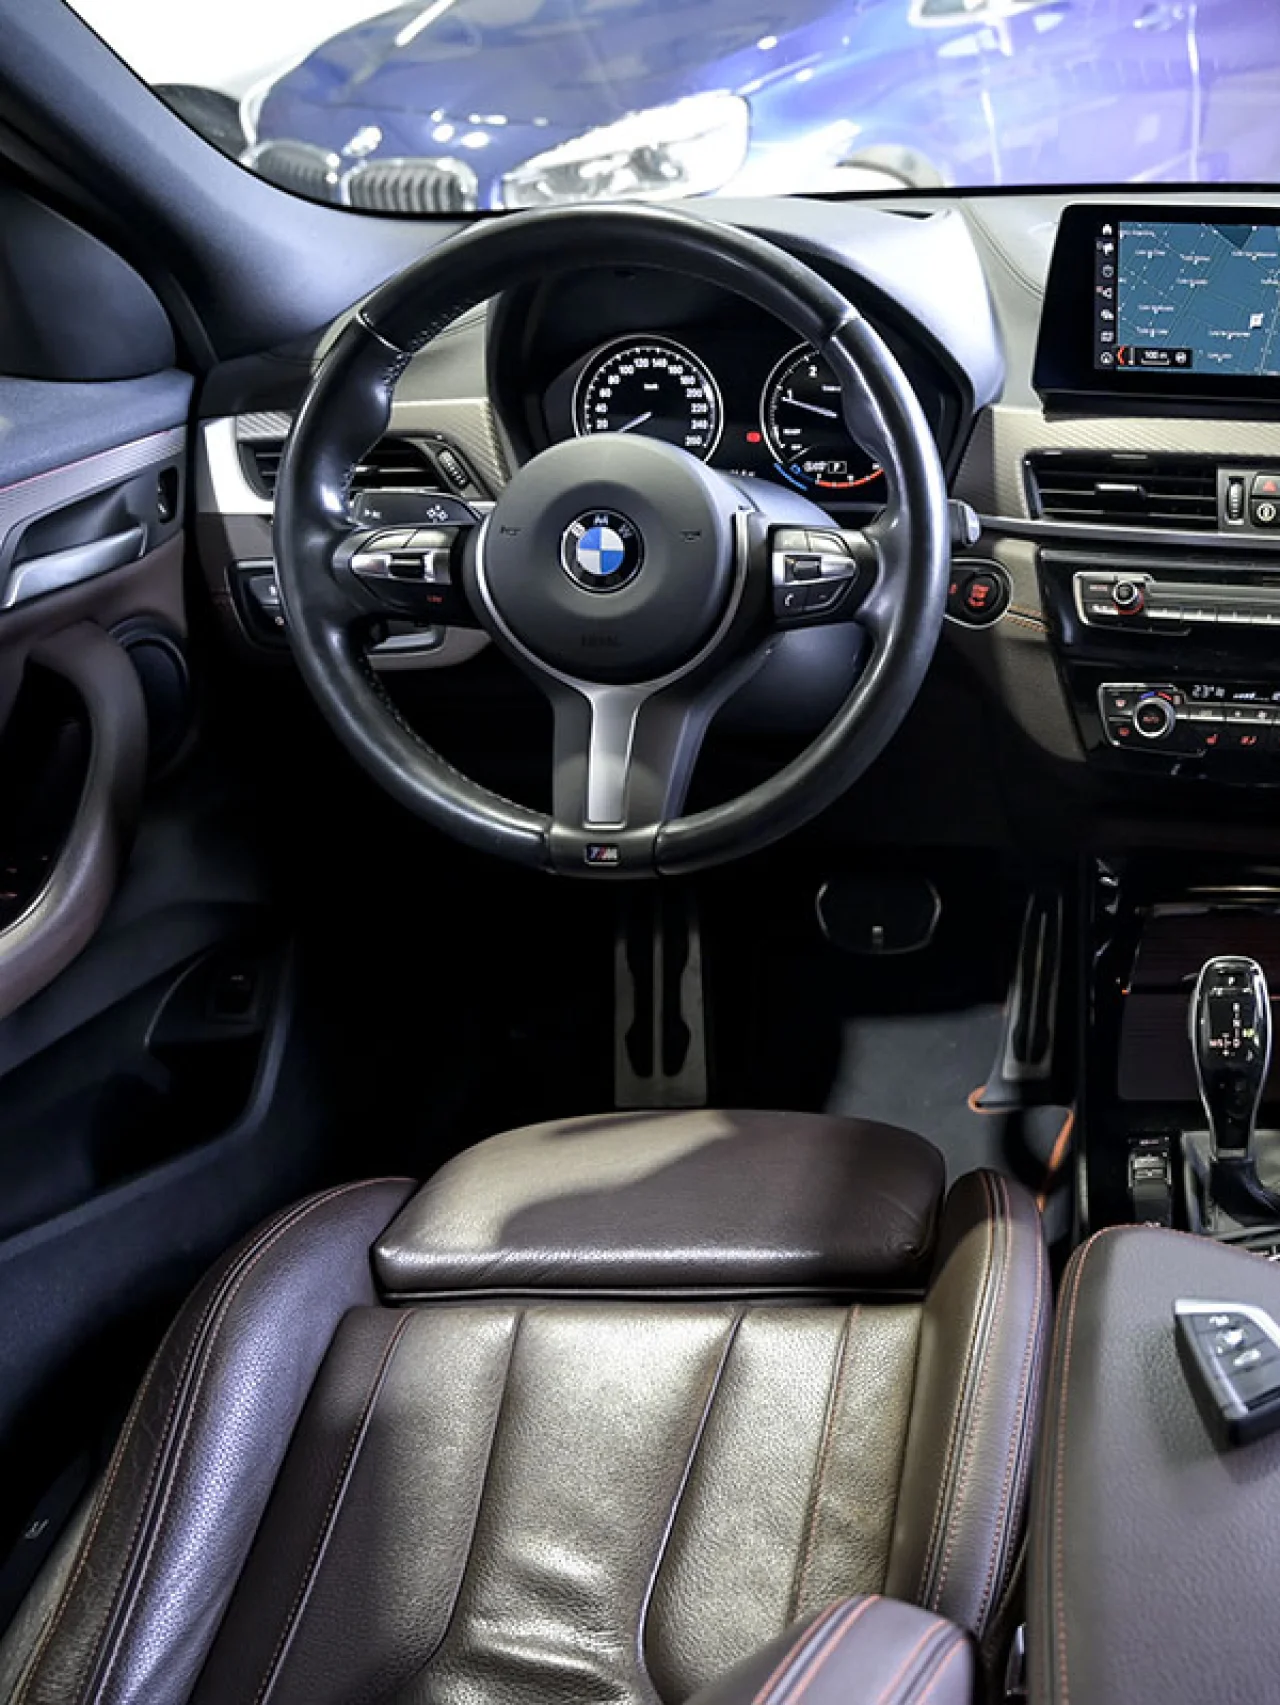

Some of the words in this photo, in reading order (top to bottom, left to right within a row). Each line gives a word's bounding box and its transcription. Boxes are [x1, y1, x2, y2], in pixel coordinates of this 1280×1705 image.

[634, 358, 649, 368] 120
[652, 358, 668, 368] 140
[619, 365, 634, 375] 100
[668, 365, 684, 375] 160
[808, 365, 817, 378] 2
[608, 375, 621, 385] 80
[680, 375, 696, 385] 180
[599, 388, 612, 398] 60
[686, 388, 703, 398] 200
[595, 403, 608, 413] 40
[691, 403, 707, 413] 220
[597, 420, 608, 430] 20
[691, 420, 708, 430] 240
[685, 435, 702, 446] 260
[570, 513, 632, 538] BMW
